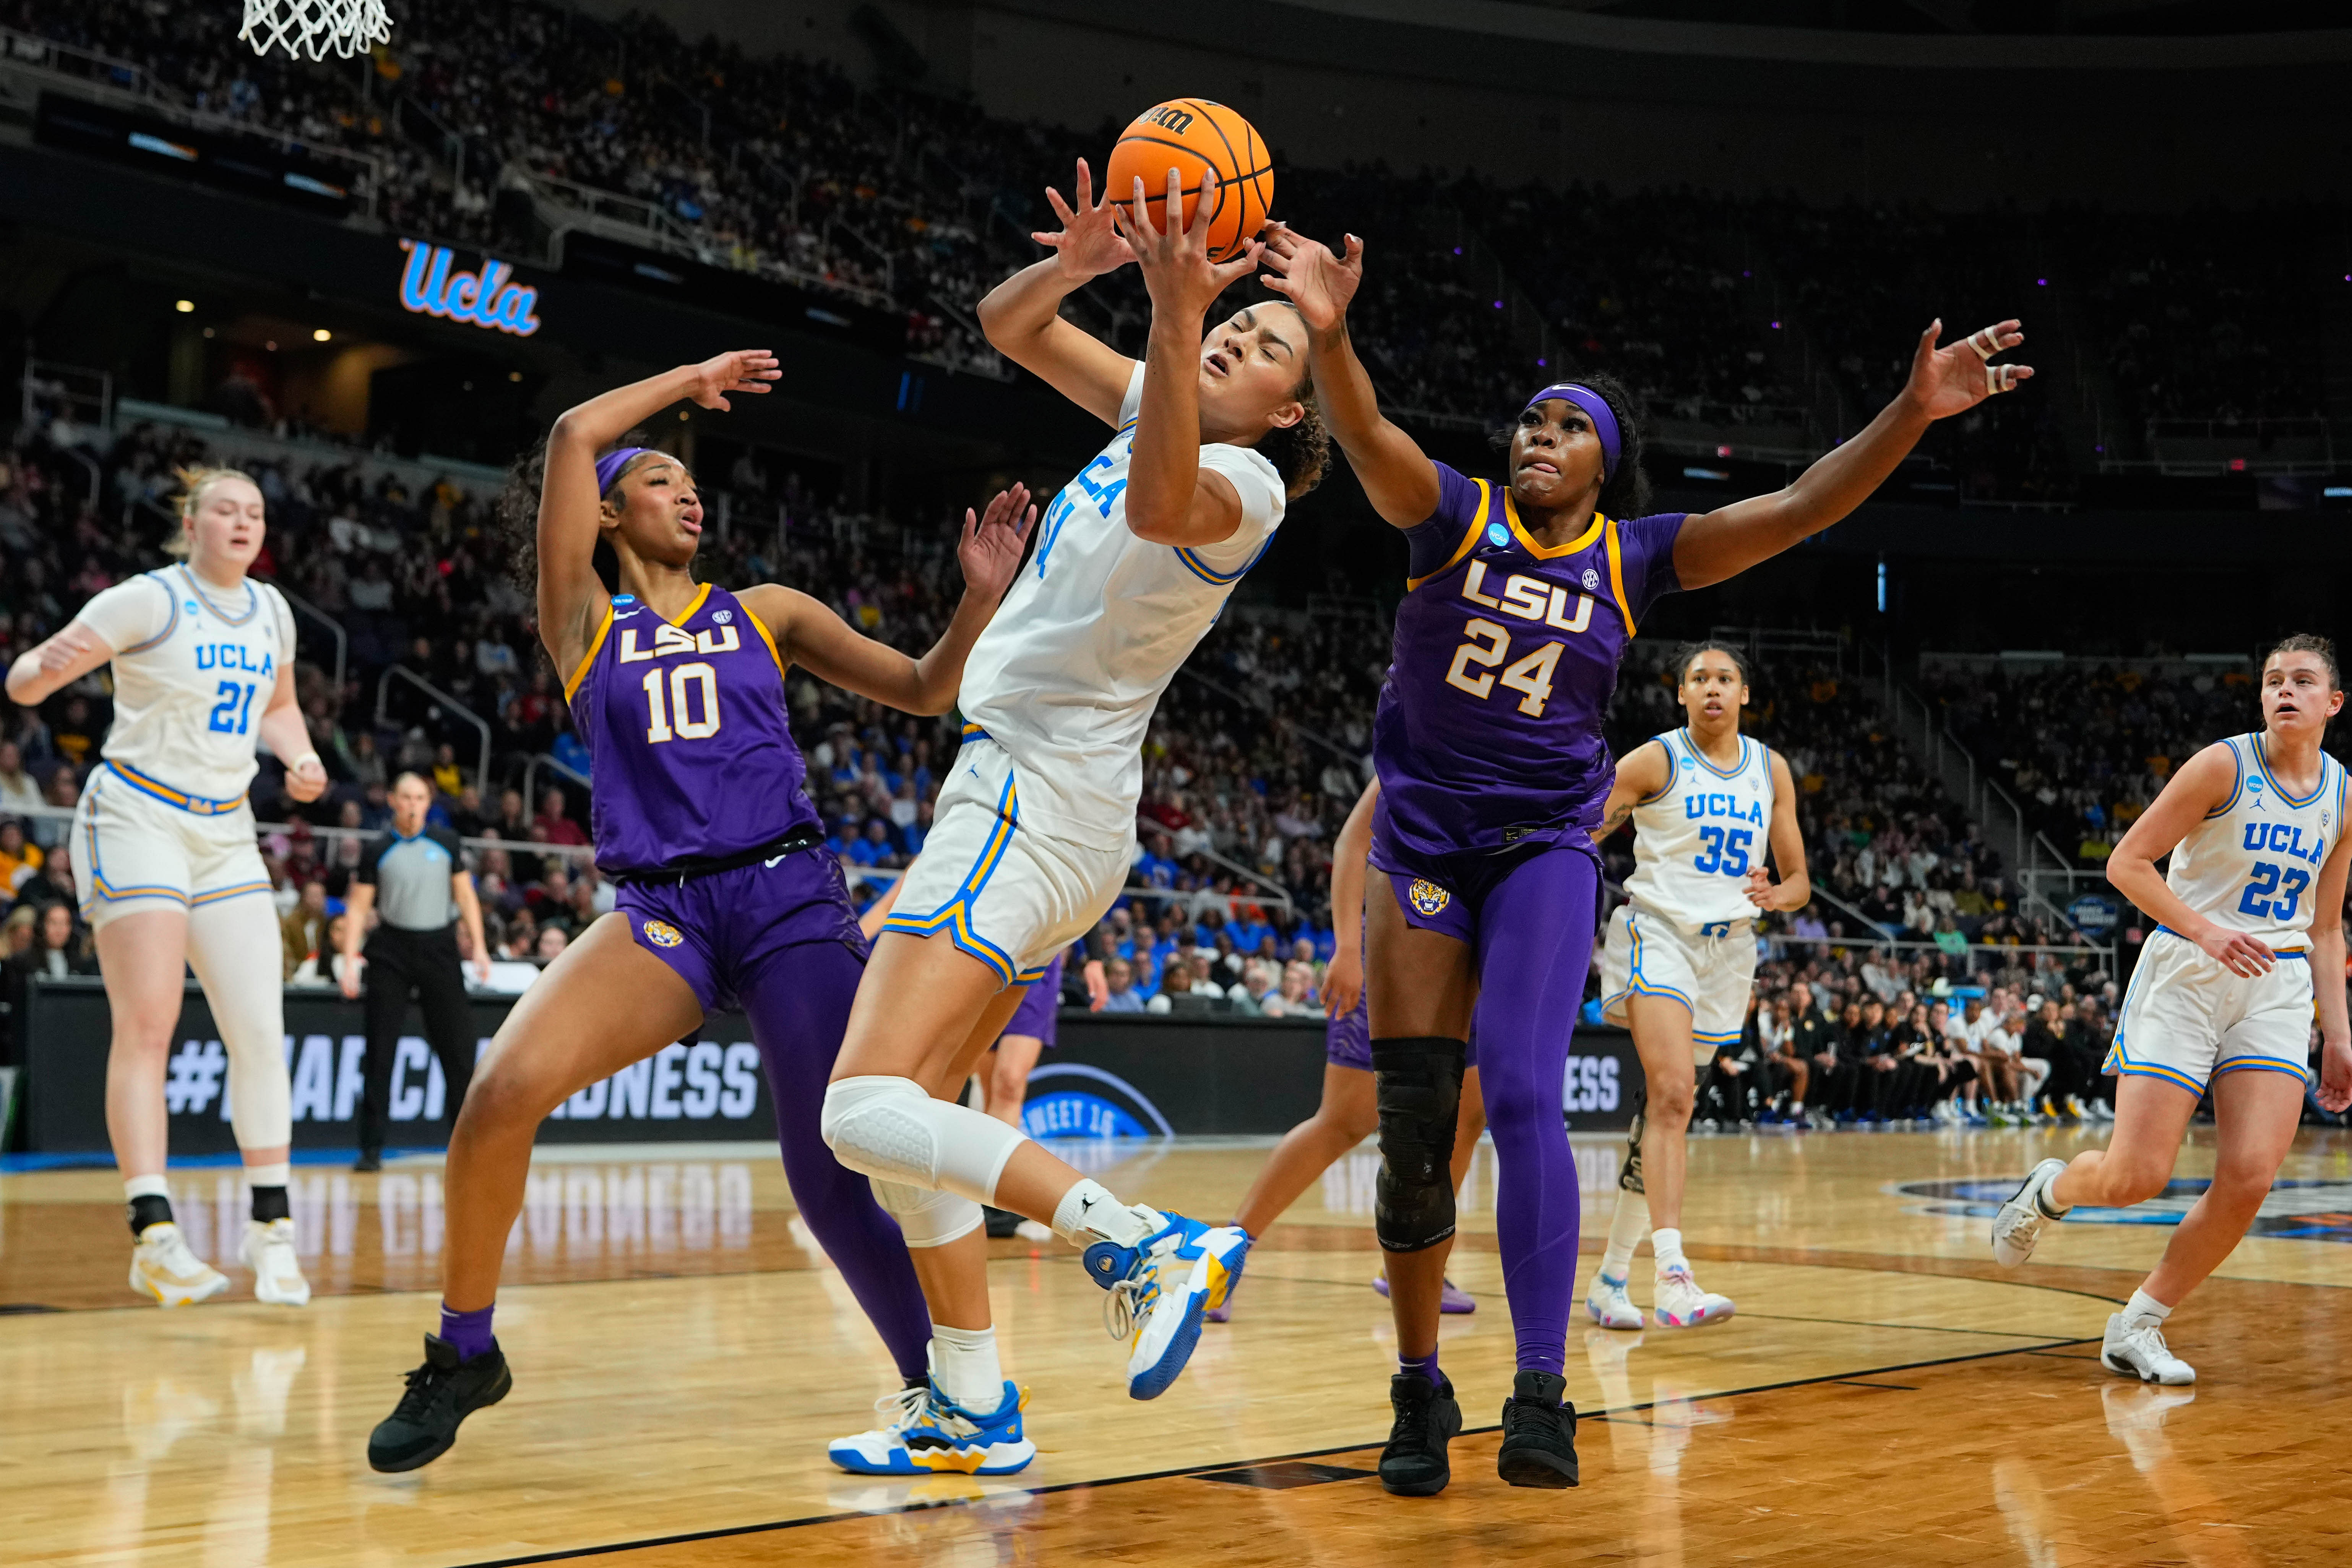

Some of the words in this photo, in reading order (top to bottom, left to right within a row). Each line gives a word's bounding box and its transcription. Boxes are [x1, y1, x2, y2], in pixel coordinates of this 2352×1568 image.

[1490, 531, 1507, 544] NCAA
[1461, 558, 1595, 633] LSU
[1583, 570, 1598, 588] SEC
[196, 644, 273, 680] UCLA
[620, 623, 741, 663] LSU
[1445, 618, 1565, 718] 24
[209, 679, 255, 735] 21
[643, 662, 721, 744] 10
[1685, 793, 1763, 829] UCLA
[1694, 825, 1753, 877] 35
[2243, 823, 2323, 870] UCLA
[2238, 861, 2310, 921] 23
